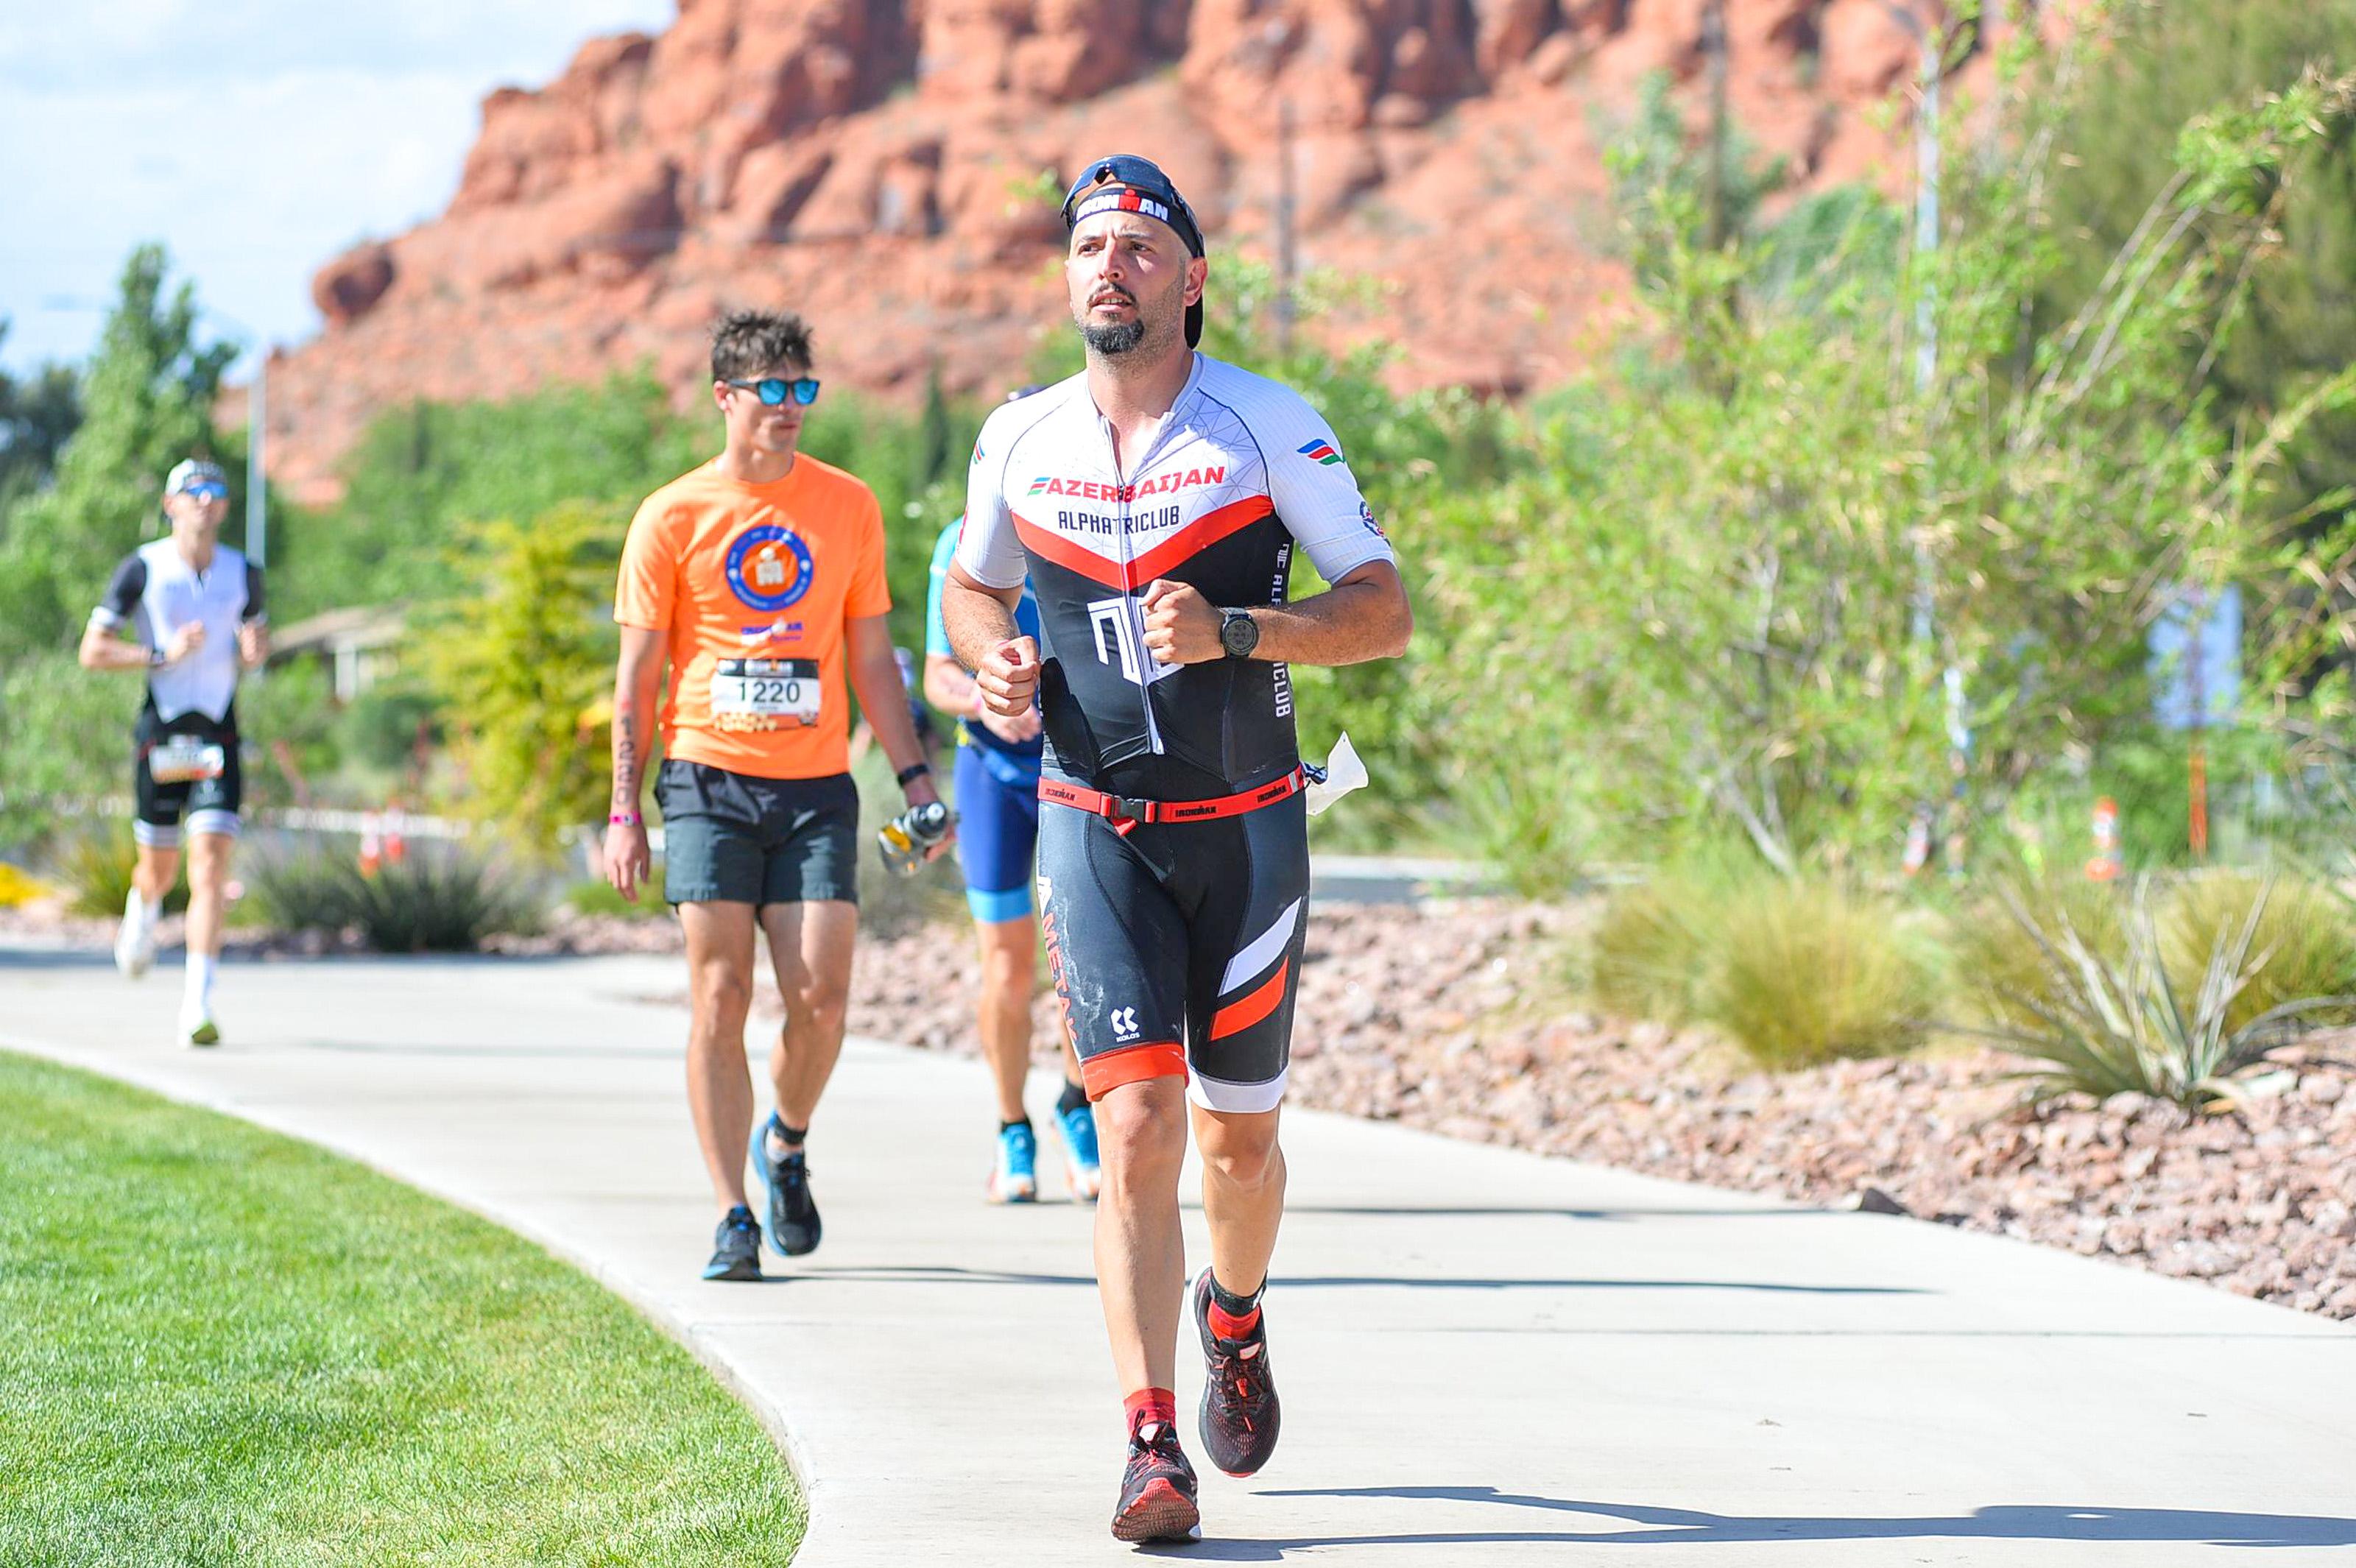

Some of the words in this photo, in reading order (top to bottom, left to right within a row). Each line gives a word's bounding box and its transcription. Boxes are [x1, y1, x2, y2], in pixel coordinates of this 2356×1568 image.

[1046, 466, 1225, 504] AZERBAIJAN
[736, 679, 801, 704] 1220
[1175, 805, 1216, 818] IRONMAN
